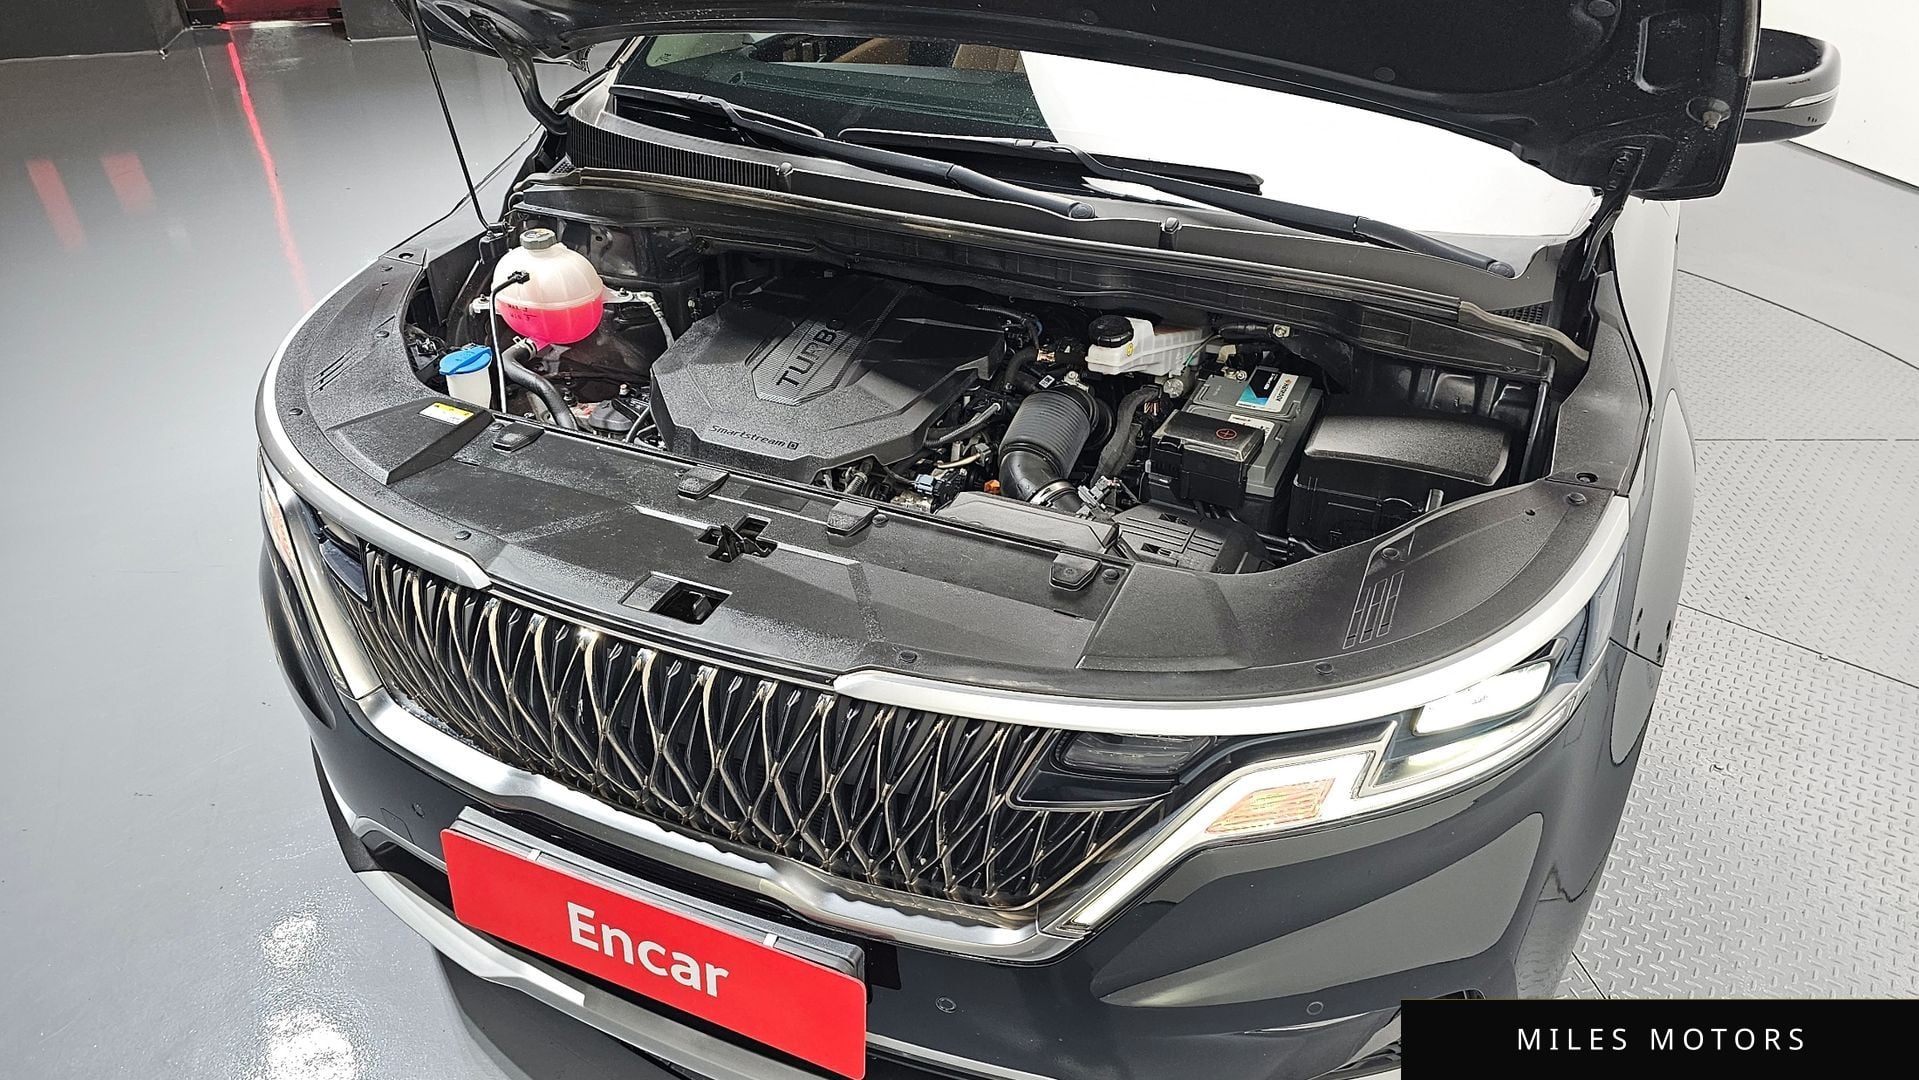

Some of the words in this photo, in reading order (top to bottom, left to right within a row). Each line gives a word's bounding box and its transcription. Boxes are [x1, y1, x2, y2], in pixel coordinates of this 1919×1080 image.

[776, 318, 847, 387] TURBO
[709, 425, 786, 447] Smartstream
[567, 901, 729, 998] Encar
